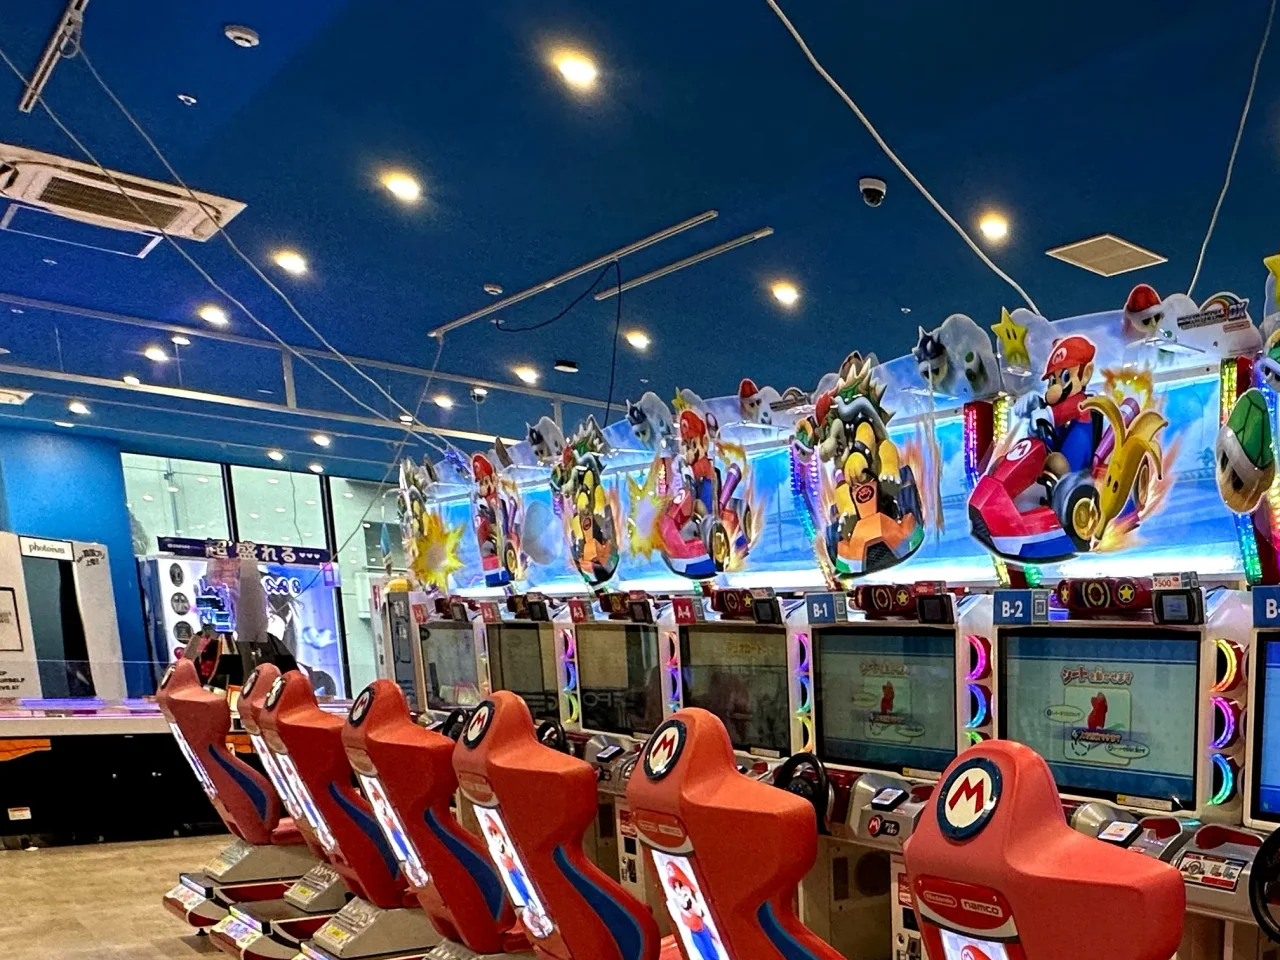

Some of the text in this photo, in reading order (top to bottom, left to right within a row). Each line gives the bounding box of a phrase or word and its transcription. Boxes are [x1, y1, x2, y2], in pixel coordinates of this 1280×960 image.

[677, 605, 691, 619] A-4
[813, 602, 829, 618] B-1
[1001, 600, 1023, 618] B-2
[473, 711, 487, 731] M
[652, 733, 676, 760] M
[948, 777, 984, 815] M
[963, 900, 1000, 915] namco
